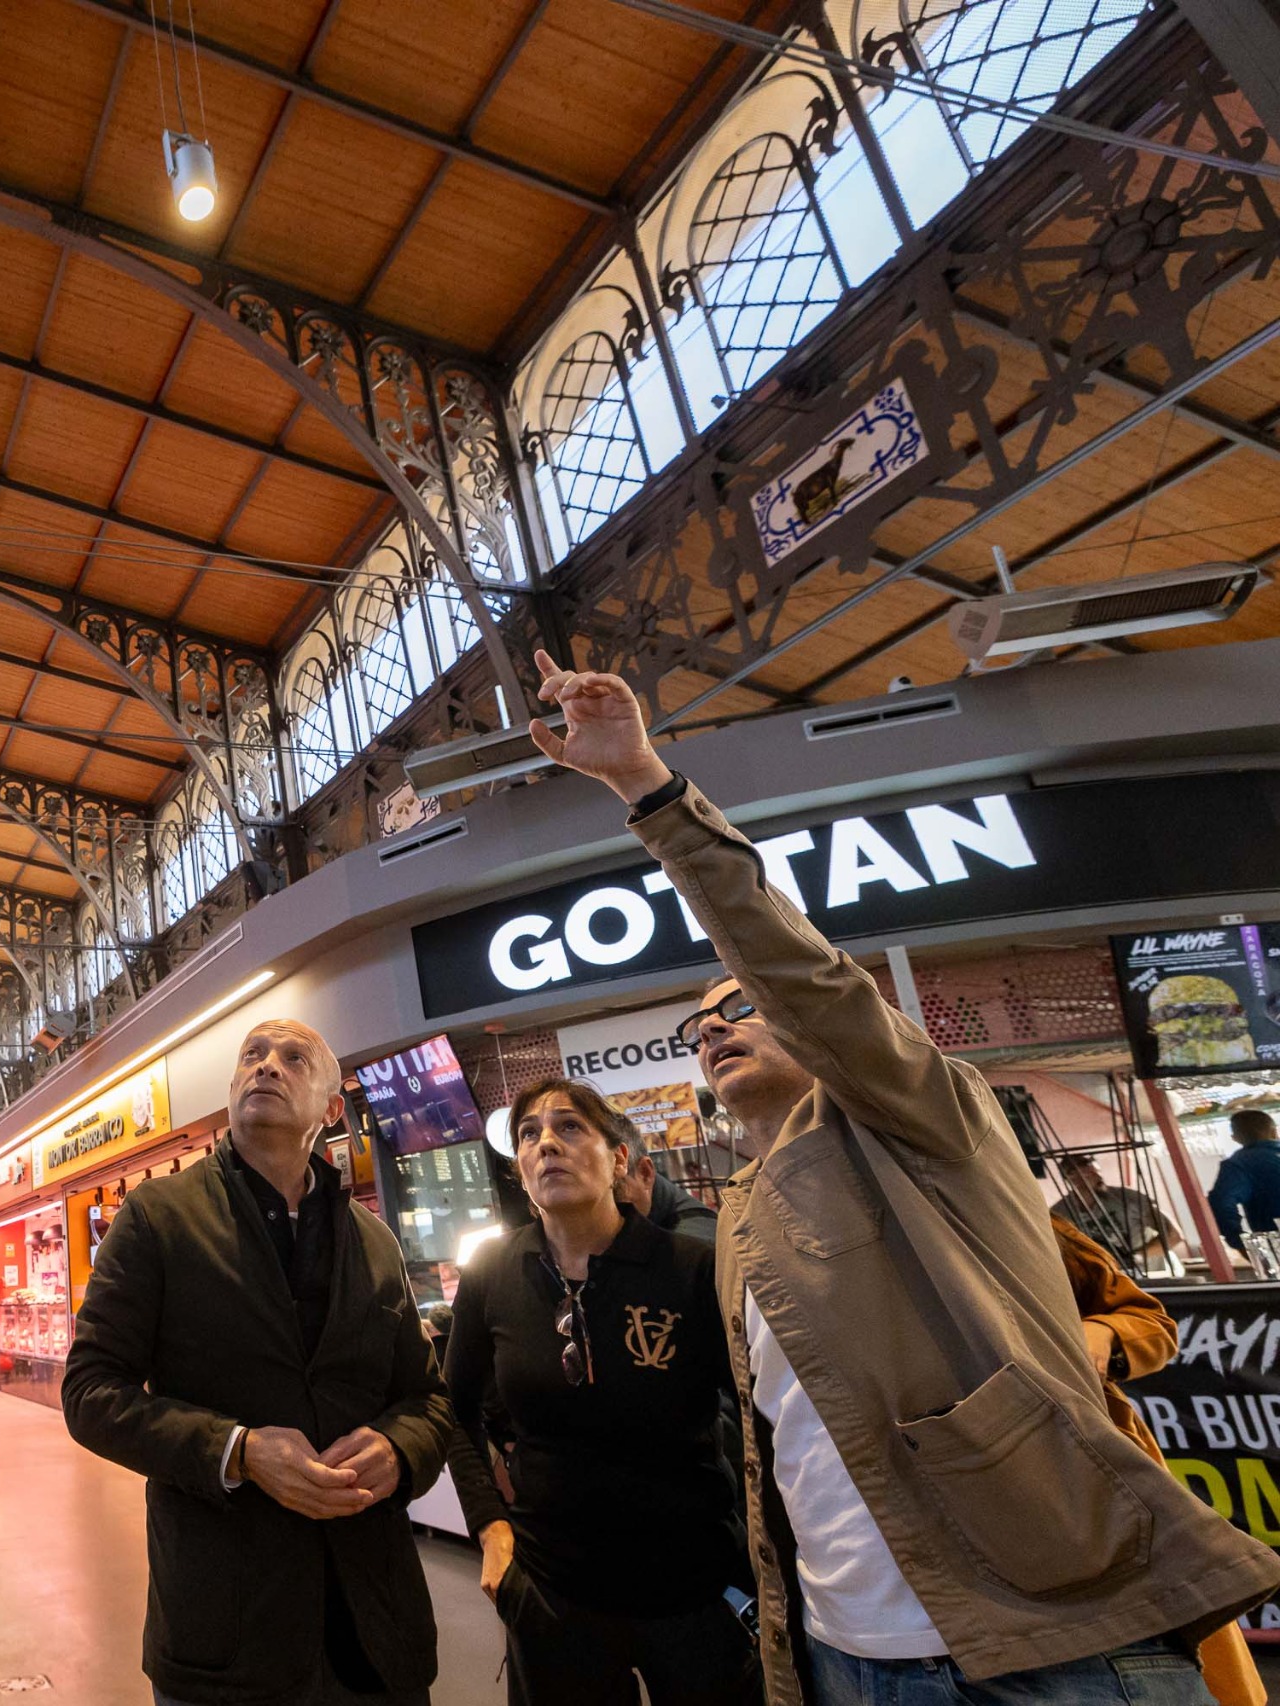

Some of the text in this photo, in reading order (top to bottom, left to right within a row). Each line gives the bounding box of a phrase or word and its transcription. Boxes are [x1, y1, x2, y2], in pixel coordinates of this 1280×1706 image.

[1131, 932, 1227, 956] LIL WAYNE
[566, 1035, 699, 1077] RECOGE
